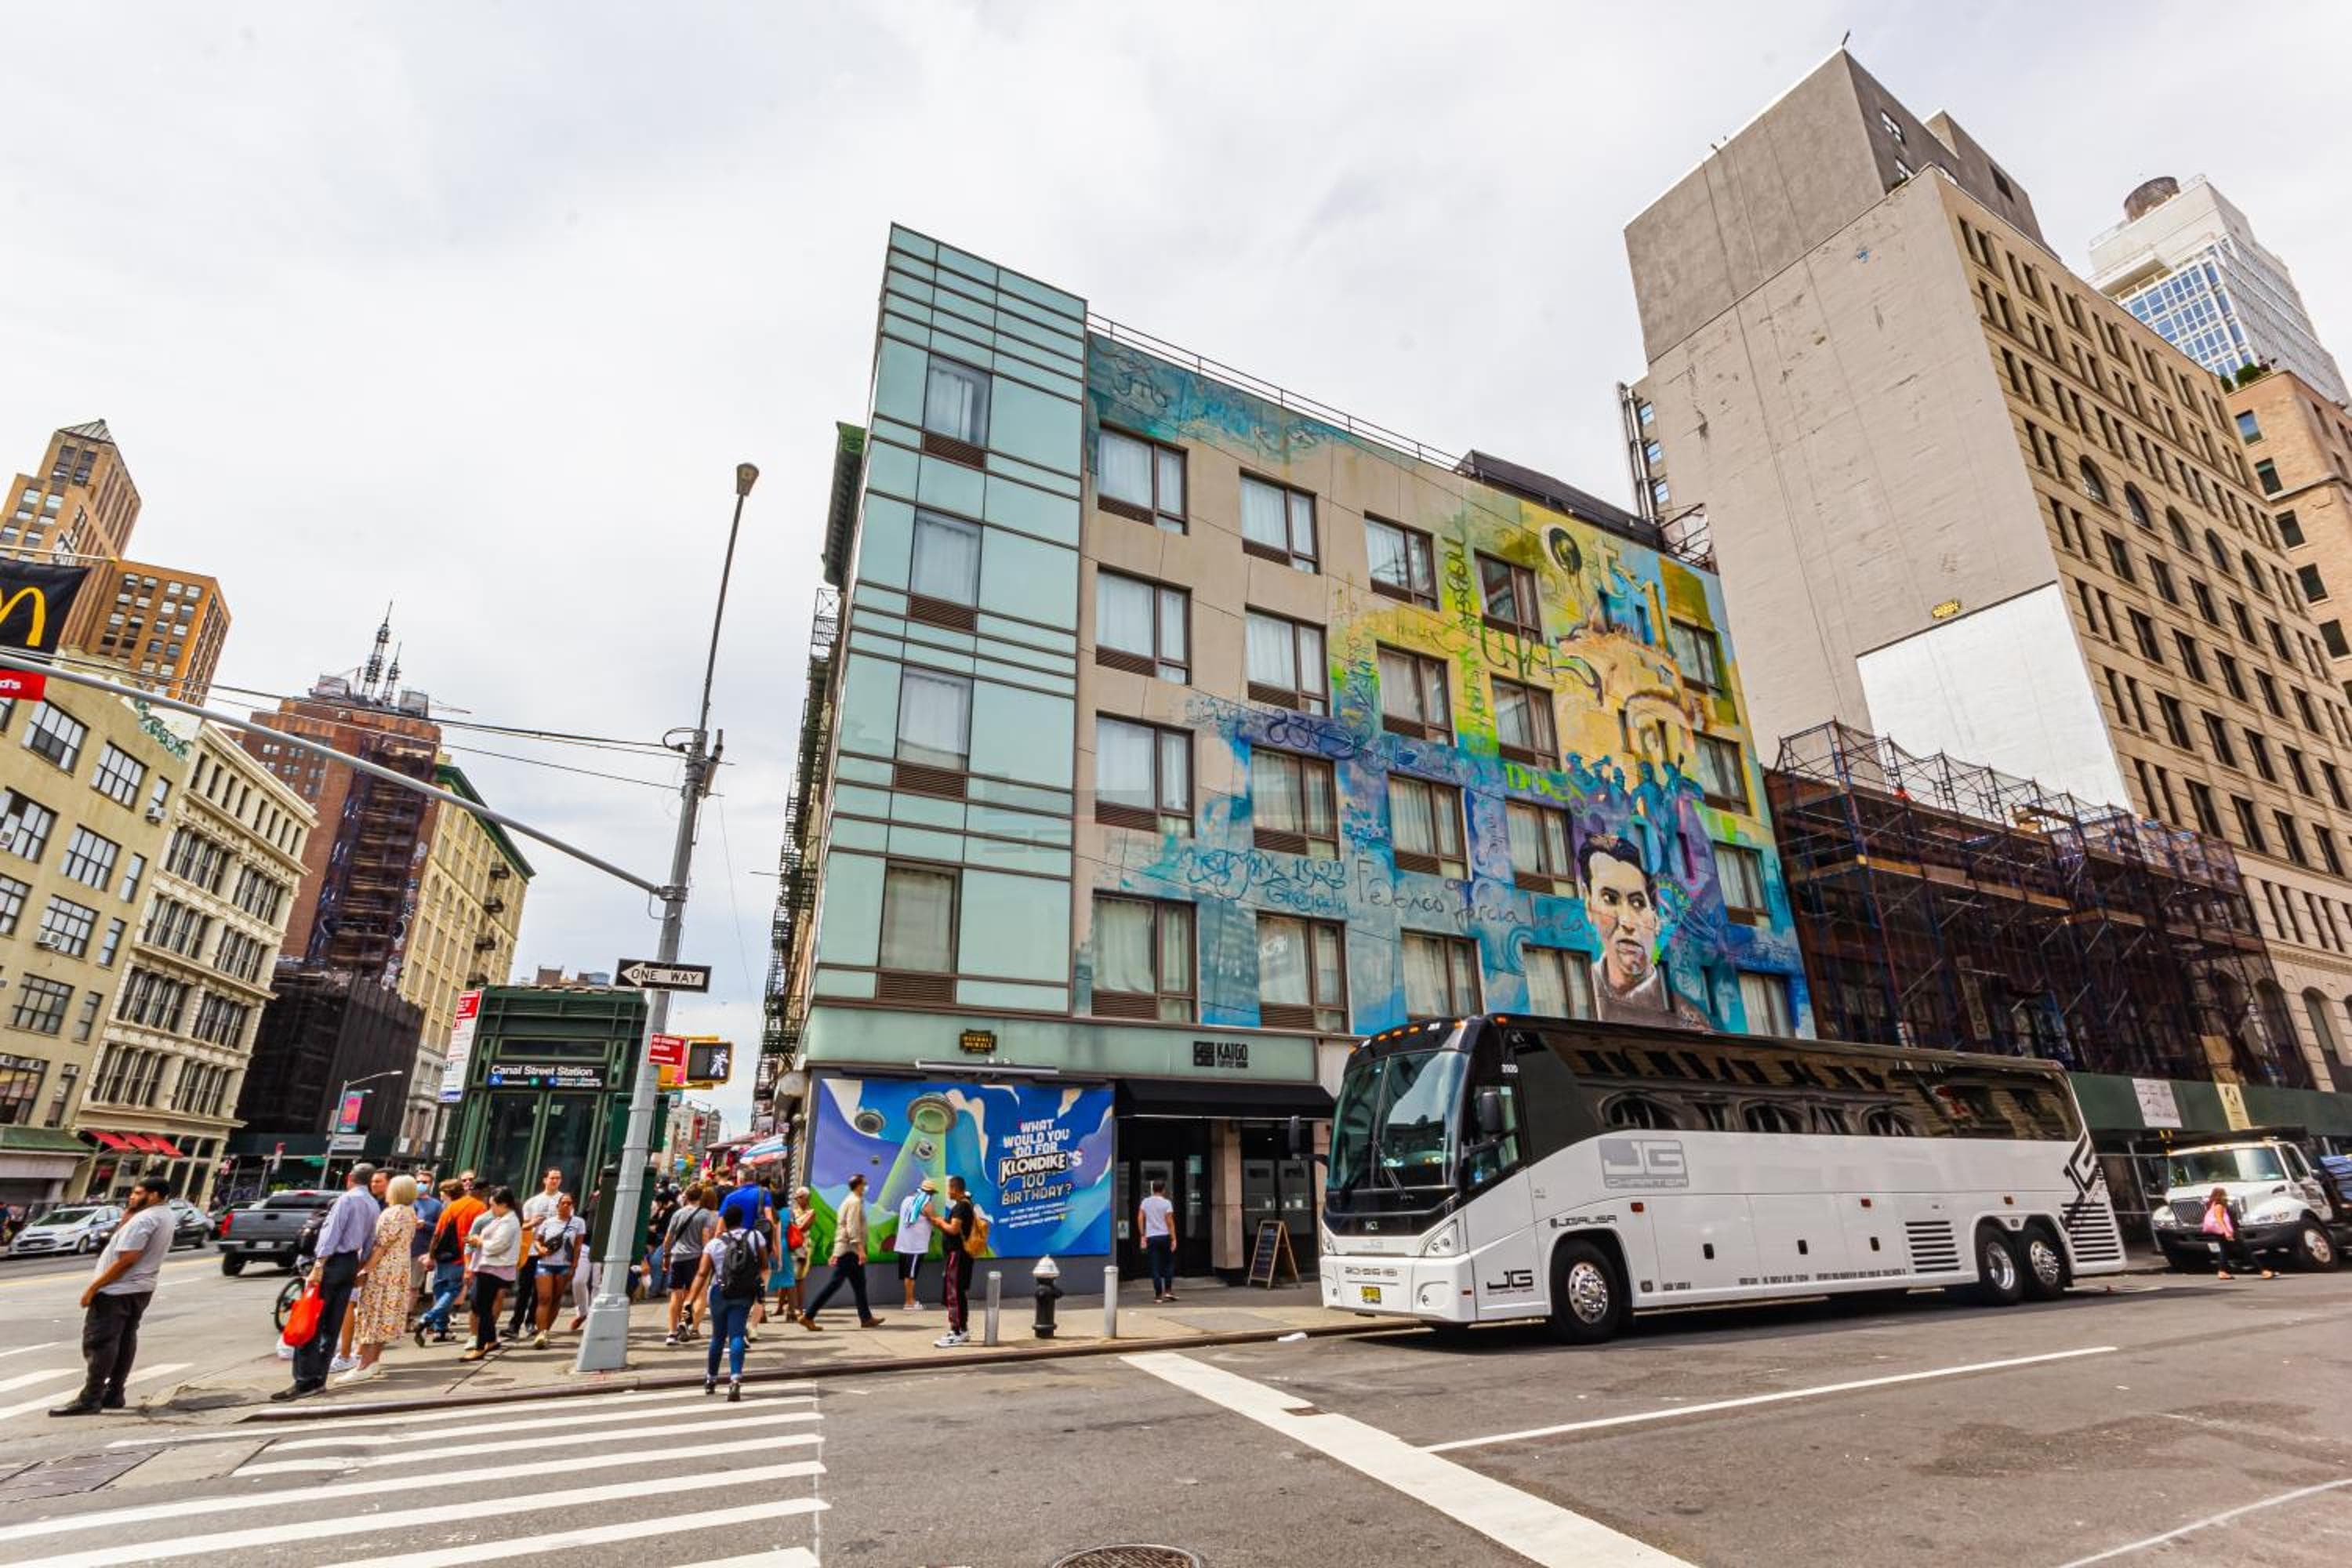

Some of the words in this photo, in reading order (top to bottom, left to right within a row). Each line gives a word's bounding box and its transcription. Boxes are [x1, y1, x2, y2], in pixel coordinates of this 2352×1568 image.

[631, 968, 659, 980] ONE
[670, 971, 699, 983] WAY
[1217, 1042, 1248, 1060] KAIGO
[491, 1065, 521, 1075] Canal
[524, 1065, 555, 1076] Street
[557, 1066, 593, 1076] Station
[1020, 1119, 1054, 1131] WHAT
[1003, 1132, 1044, 1148] WOULD
[1047, 1129, 1069, 1141] YOU
[1015, 1145, 1032, 1157] DO
[1035, 1142, 1058, 1155] FOR
[1602, 1140, 1686, 1175] JG
[1001, 1183, 1073, 1205] BIRTHDAY?
[1486, 1270, 1534, 1290] JG
